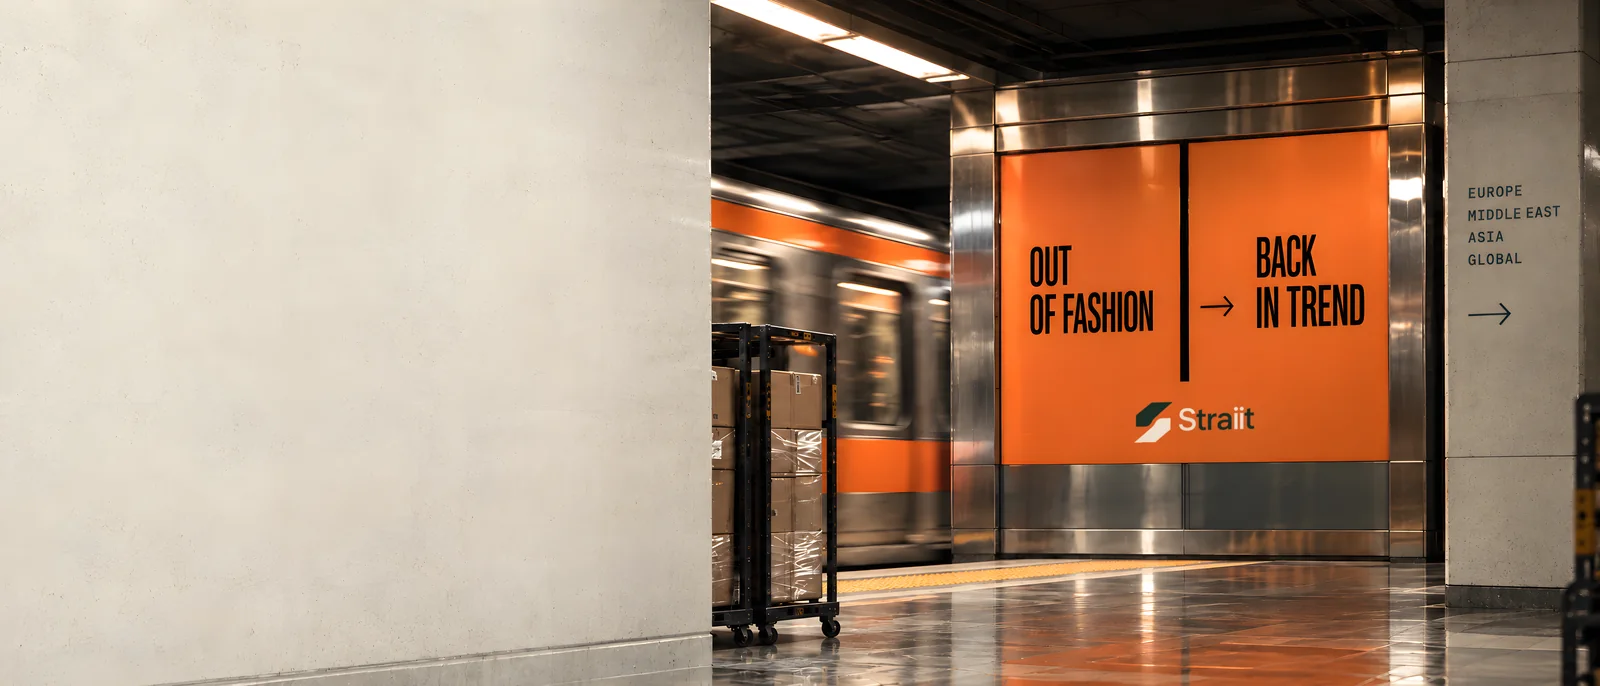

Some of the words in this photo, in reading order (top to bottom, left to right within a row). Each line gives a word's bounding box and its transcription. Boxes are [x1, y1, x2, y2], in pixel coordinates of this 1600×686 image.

[1468, 185, 1522, 198] EUROPE
[1468, 208, 1521, 221] MIDDLE
[1526, 205, 1560, 218] EAST
[1468, 231, 1504, 243] ASIA
[1030, 245, 1072, 287] OUT
[1256, 234, 1317, 278] BACK
[1468, 253, 1522, 265] GLOBAL
[1030, 293, 1057, 335] OF
[1063, 290, 1154, 334] FASHION
[1256, 286, 1279, 328] IN
[1286, 284, 1365, 327] TREND
[1178, 406, 1254, 432] Straiit
